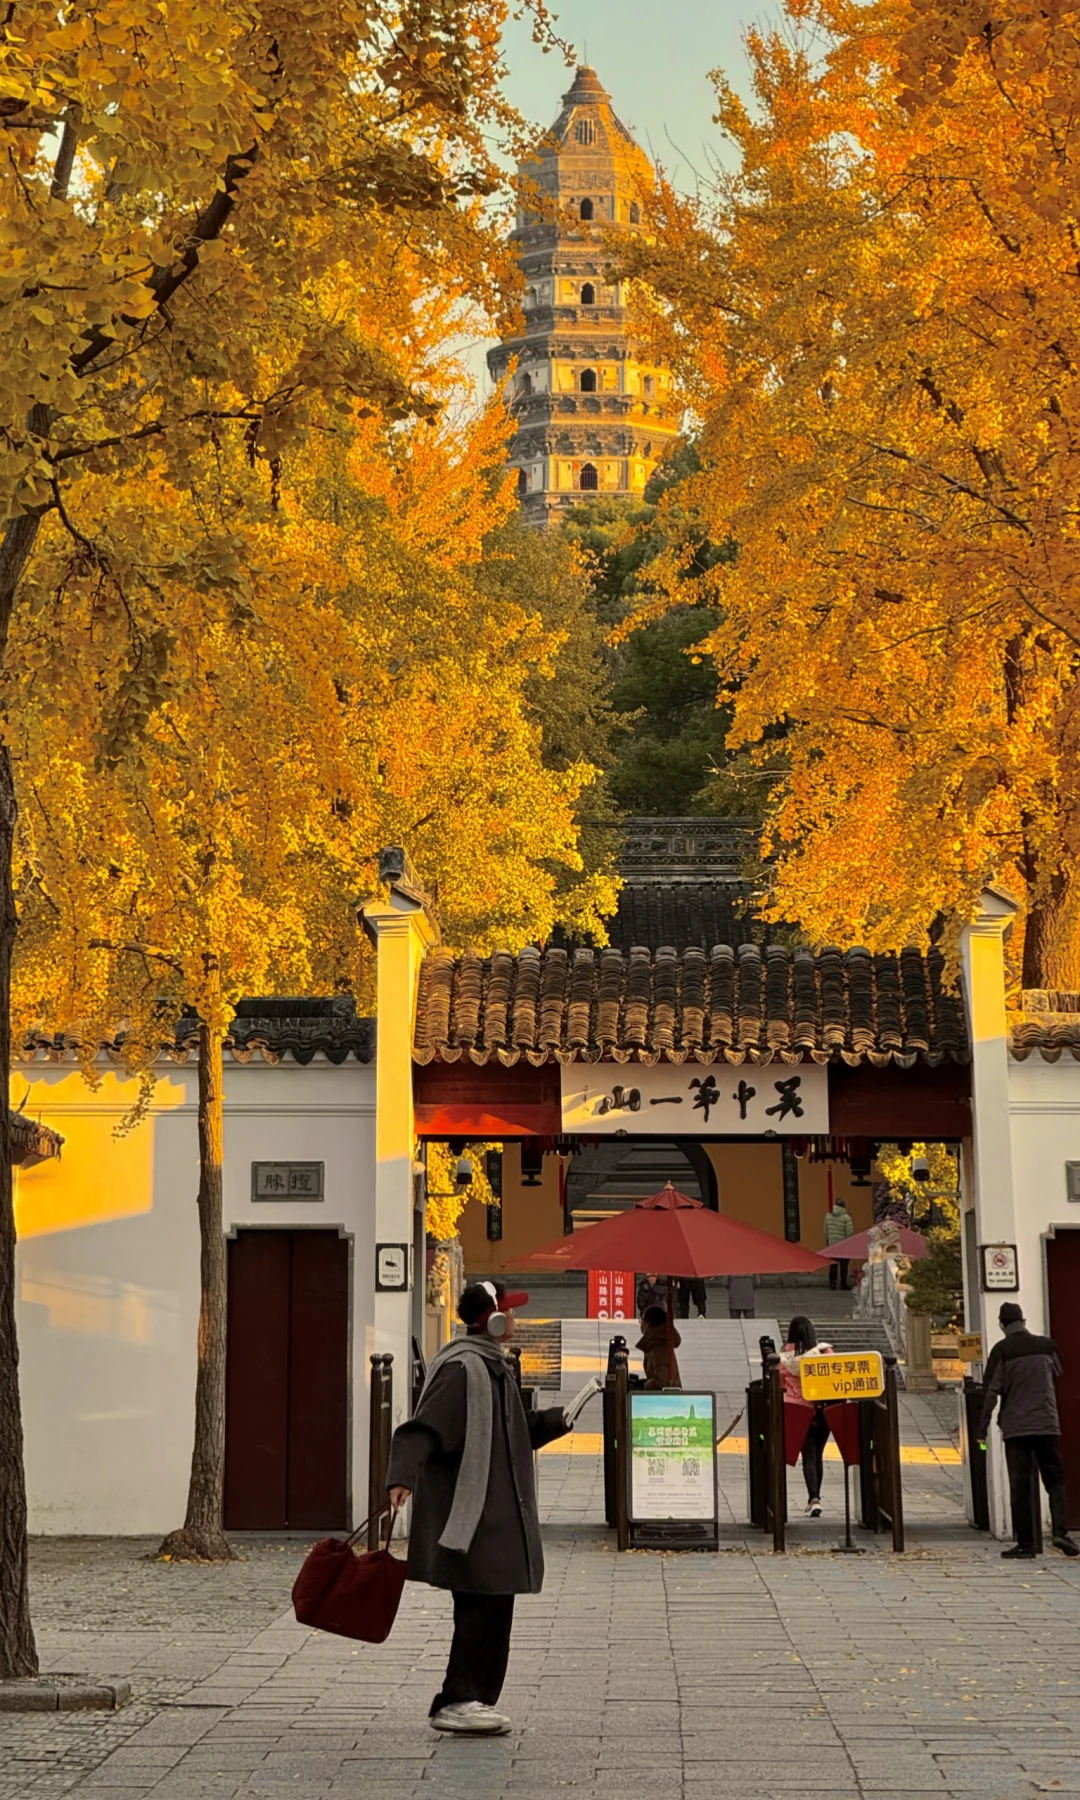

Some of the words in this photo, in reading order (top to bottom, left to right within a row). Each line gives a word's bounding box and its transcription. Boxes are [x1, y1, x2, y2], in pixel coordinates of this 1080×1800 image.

[598, 1269, 608, 1306] 山路西
[614, 1270, 624, 1307] 山路东
[803, 1360, 871, 1377] 美团专享票
[832, 1376, 879, 1394] vip通道
